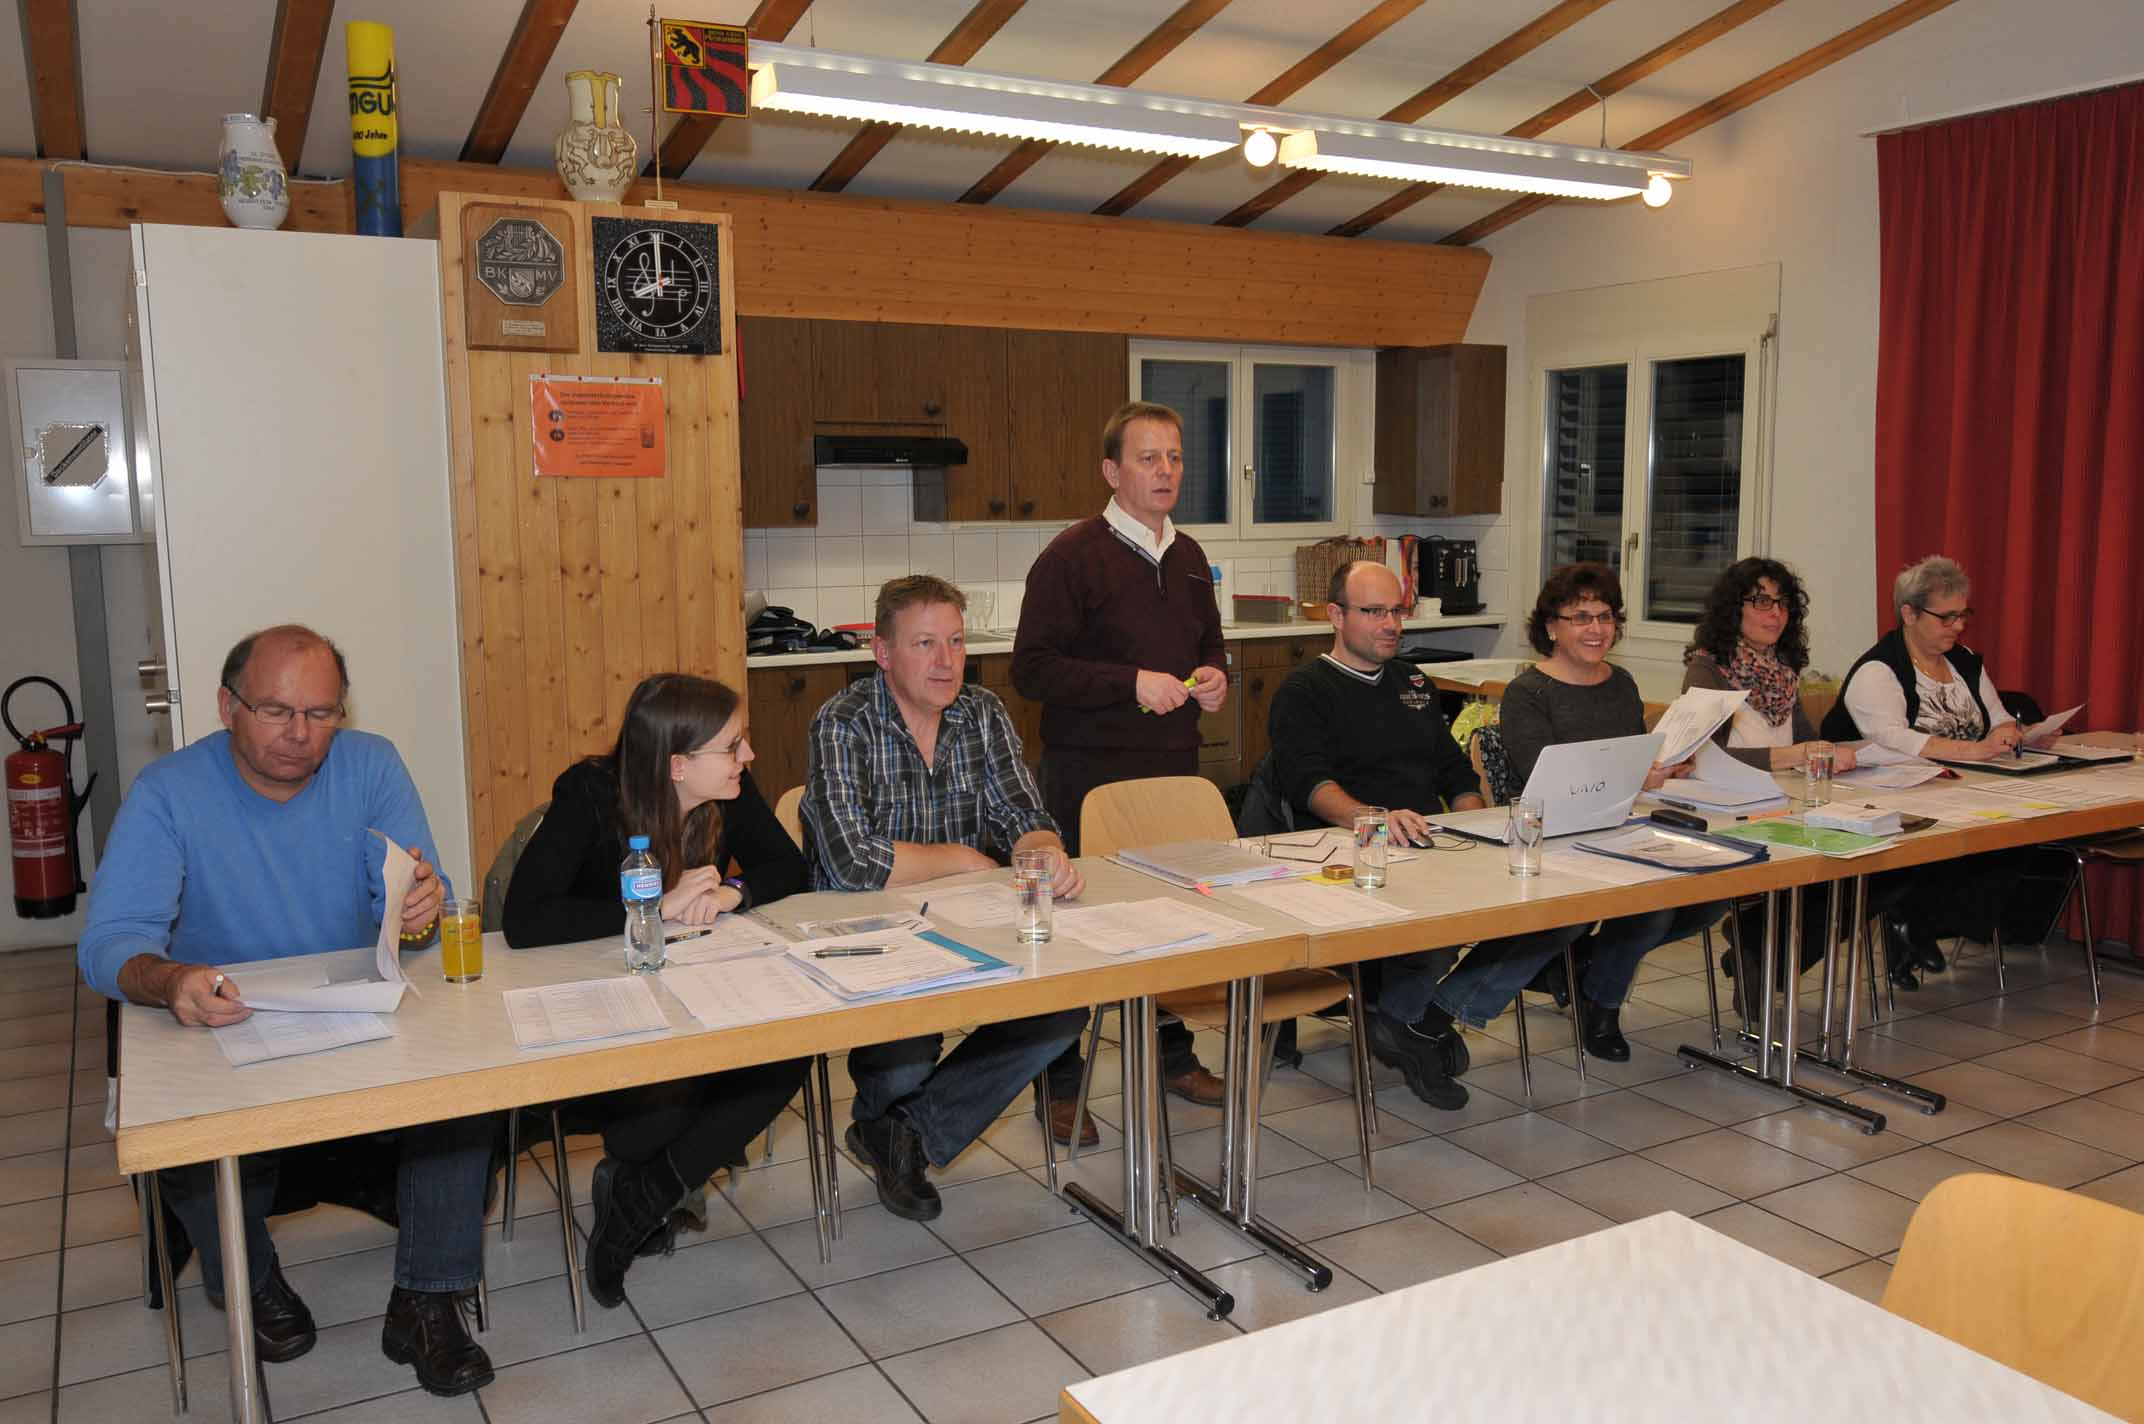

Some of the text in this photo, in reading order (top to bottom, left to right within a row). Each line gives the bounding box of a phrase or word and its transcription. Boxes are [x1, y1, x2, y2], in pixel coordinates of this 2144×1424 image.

[613, 254, 621, 262] X
[485, 266, 558, 282] BK MV
